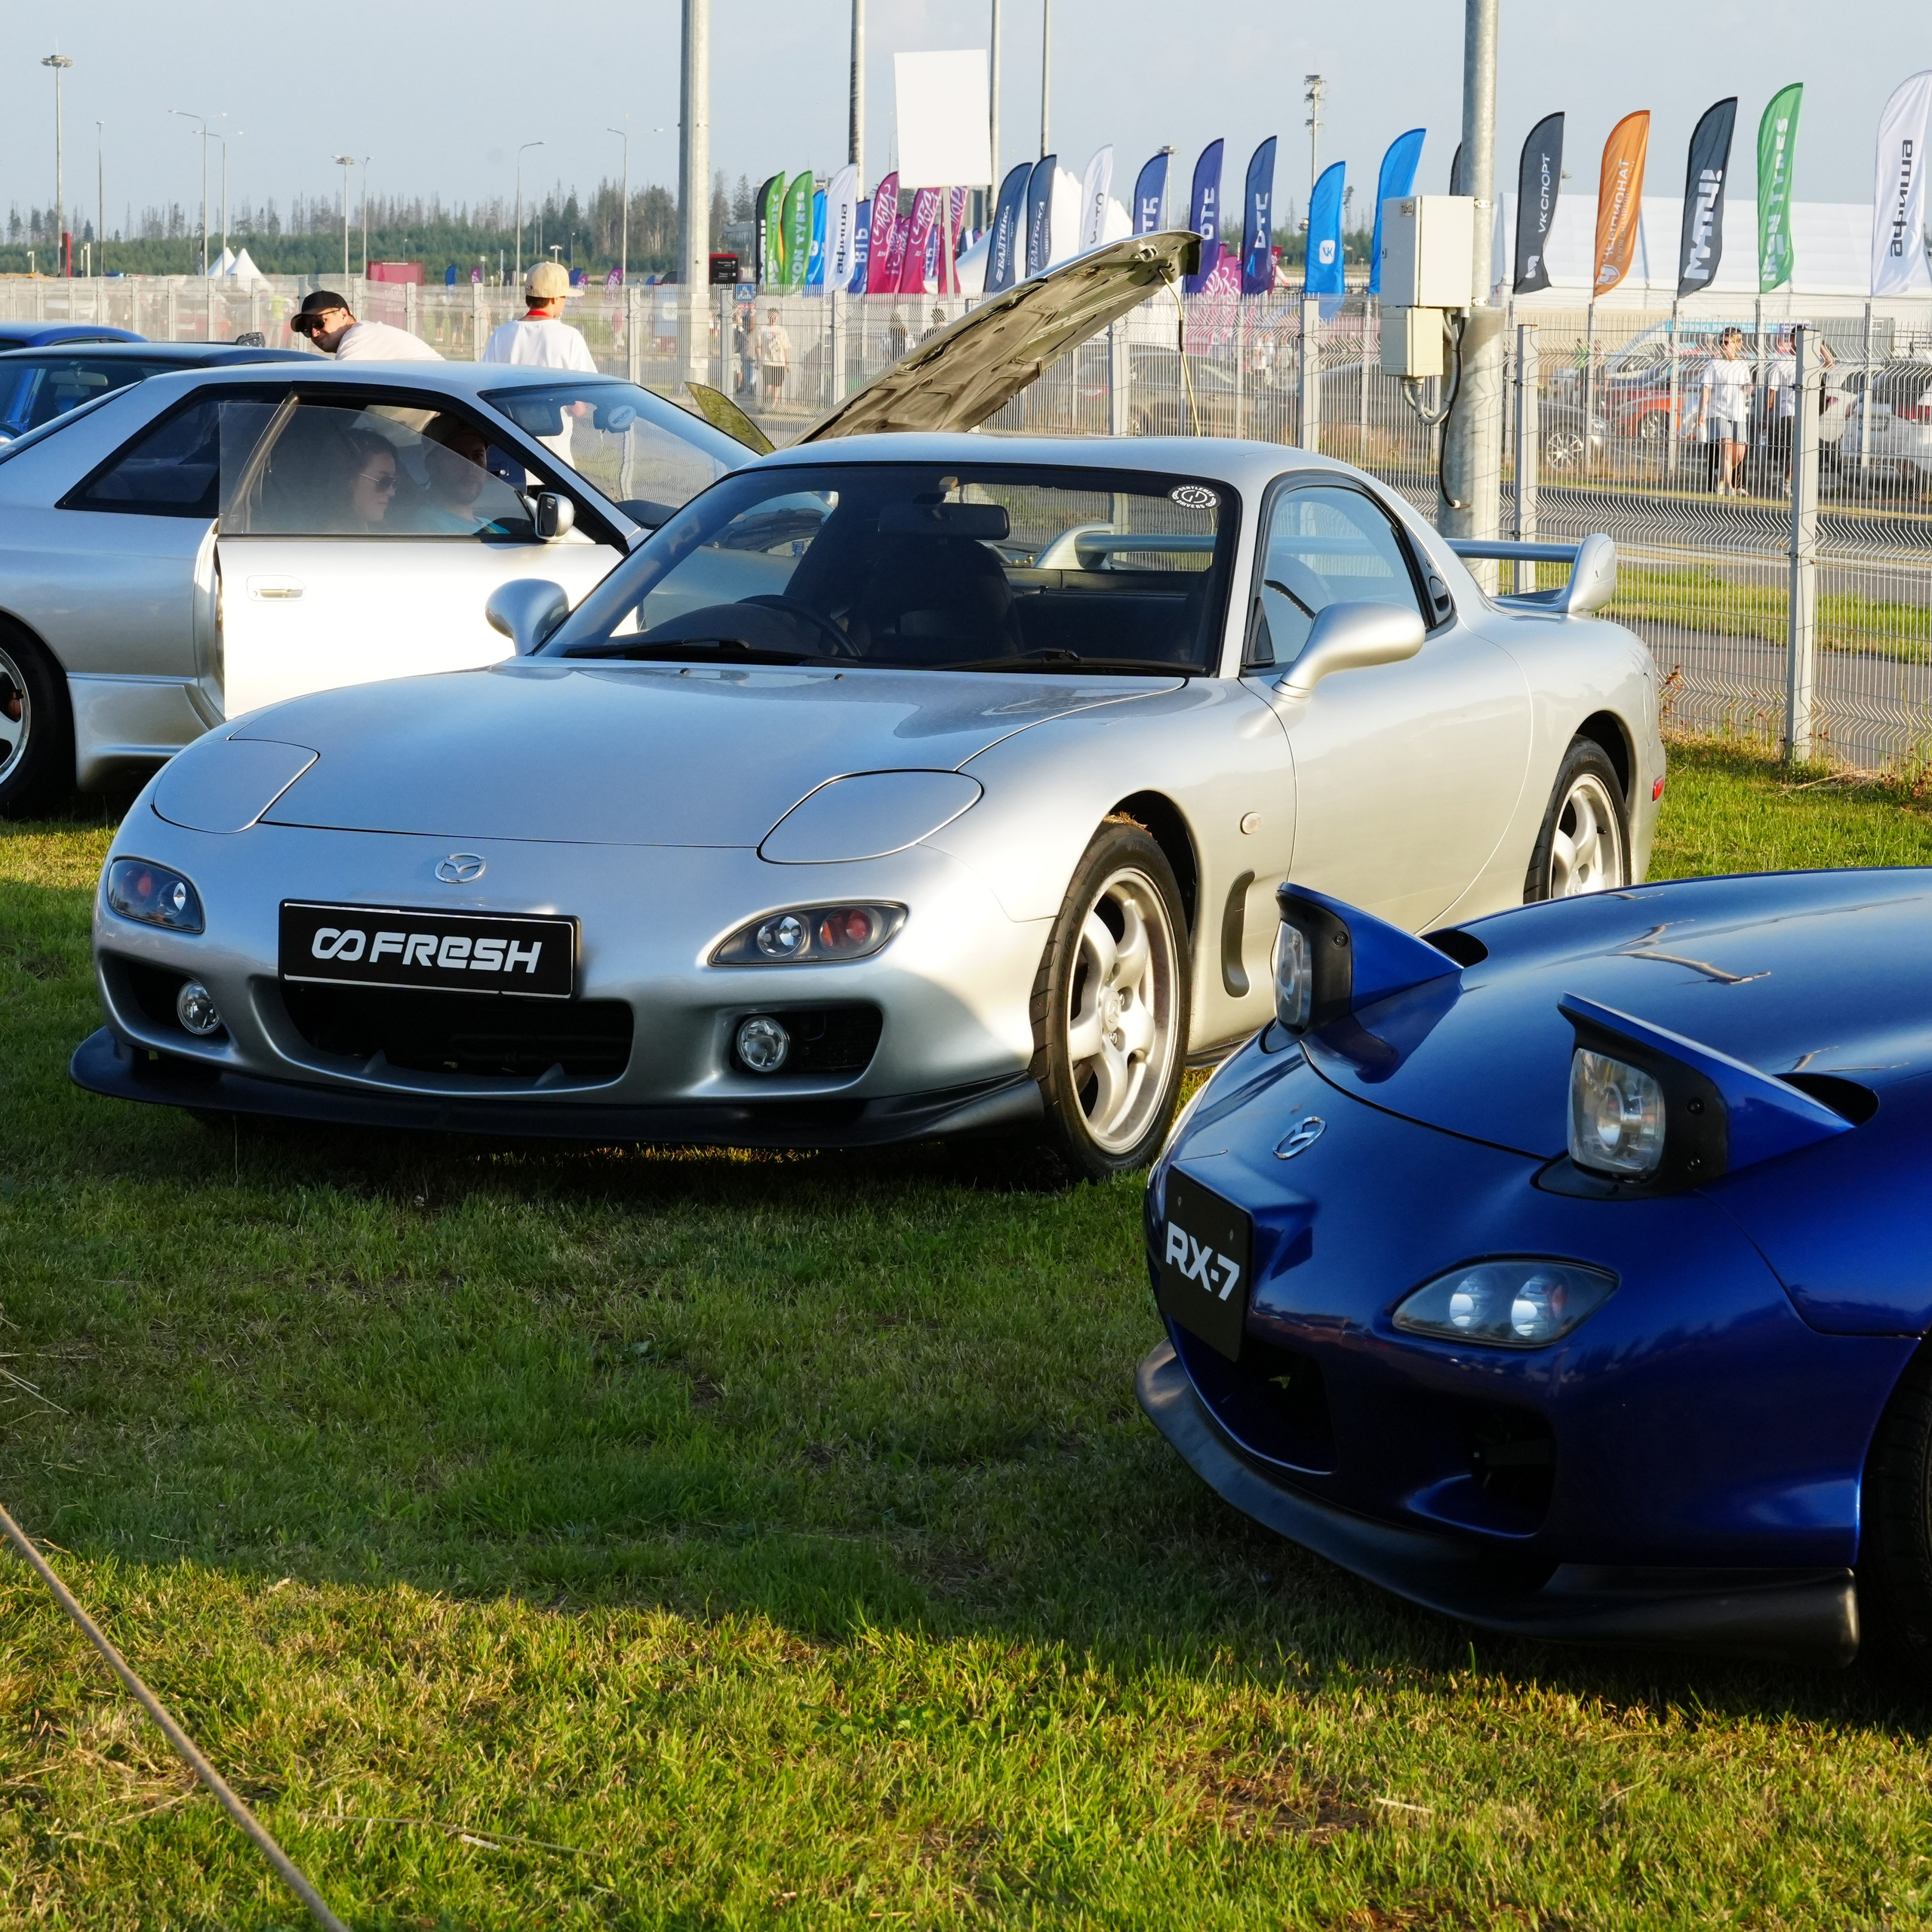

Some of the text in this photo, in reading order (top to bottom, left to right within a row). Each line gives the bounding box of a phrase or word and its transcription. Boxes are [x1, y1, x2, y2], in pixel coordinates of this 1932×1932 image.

[795, 191, 806, 245] TYRES
[1890, 139, 1913, 258] афиша
[837, 204, 847, 274] афиша
[997, 205, 1010, 271] БАЛТИКА
[1030, 201, 1045, 268] БАЛТИКА
[1176, 499, 1206, 509] DRIVERS
[1178, 485, 1216, 497] GENTLEMEN
[1165, 1220, 1240, 1301] RX-7
